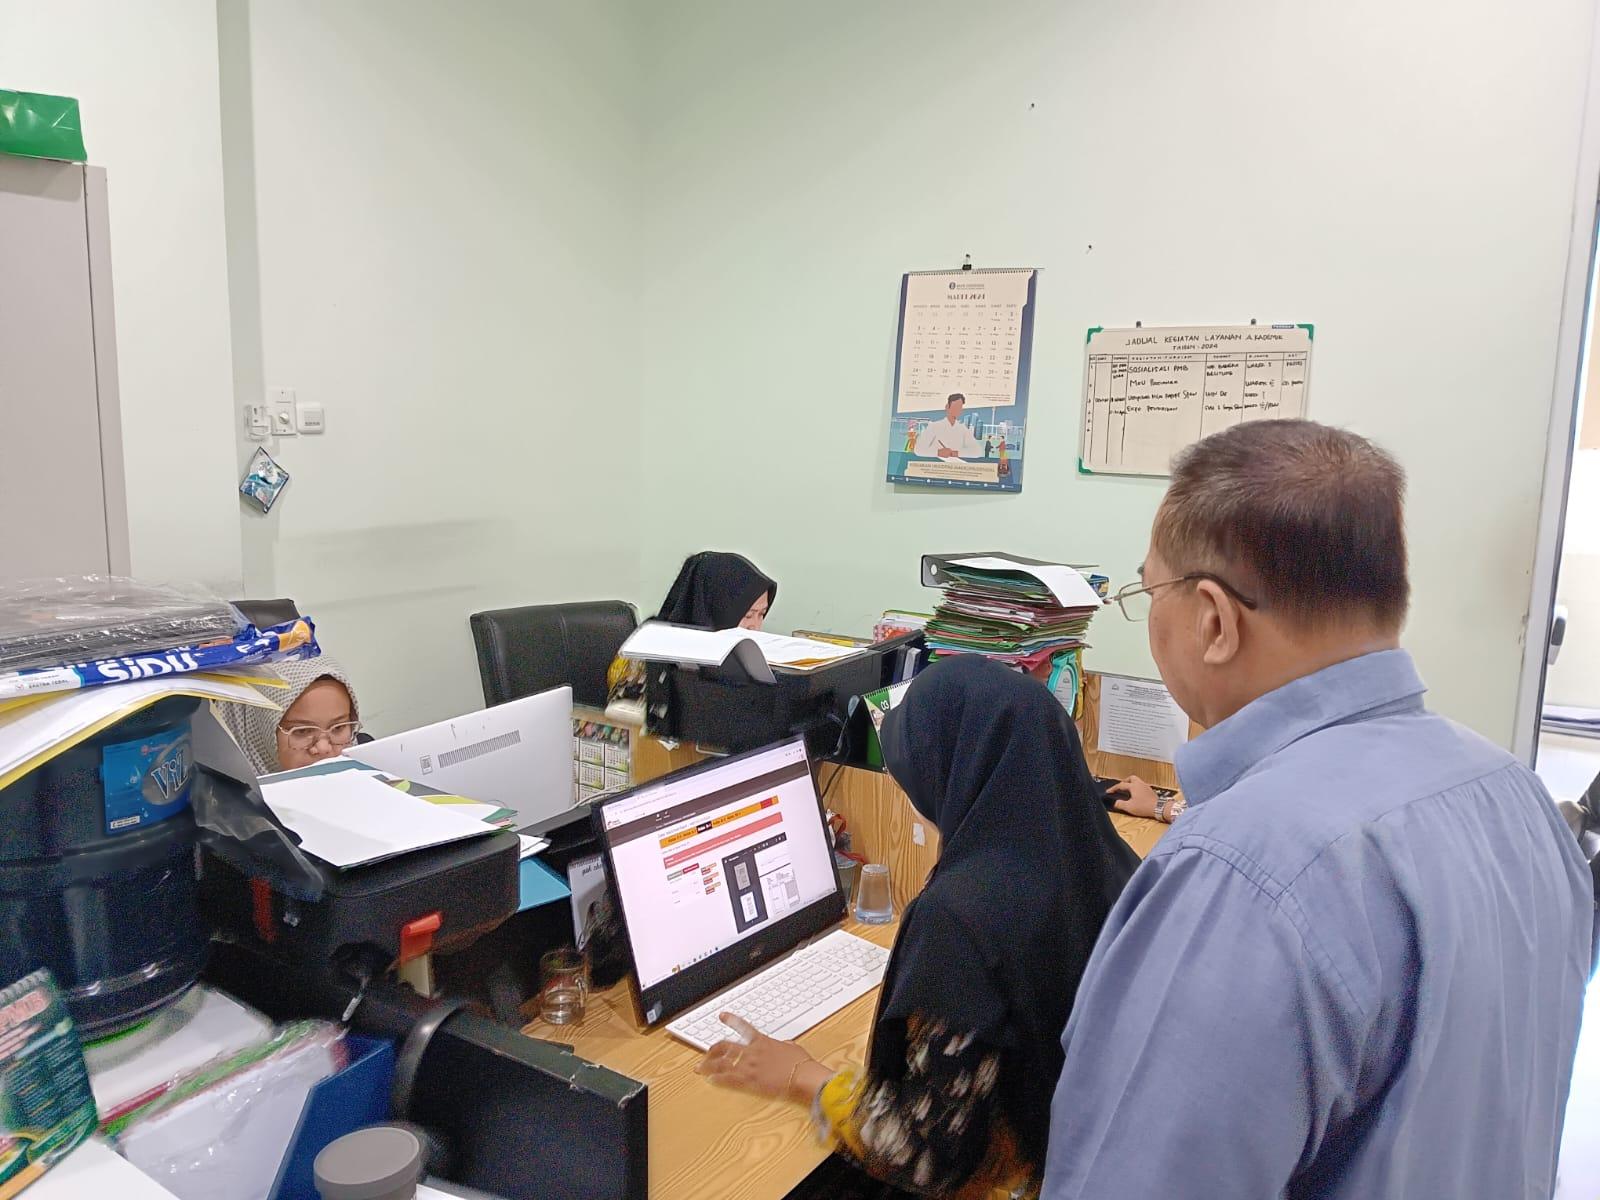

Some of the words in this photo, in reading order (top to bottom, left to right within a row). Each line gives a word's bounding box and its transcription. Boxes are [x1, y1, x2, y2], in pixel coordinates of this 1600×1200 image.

[1125, 336, 1158, 346] JADWAL
[1164, 335, 1200, 344] KEGIATAN
[1204, 333, 1242, 341] LAYANAN
[1173, 364, 1189, 372] PMB
